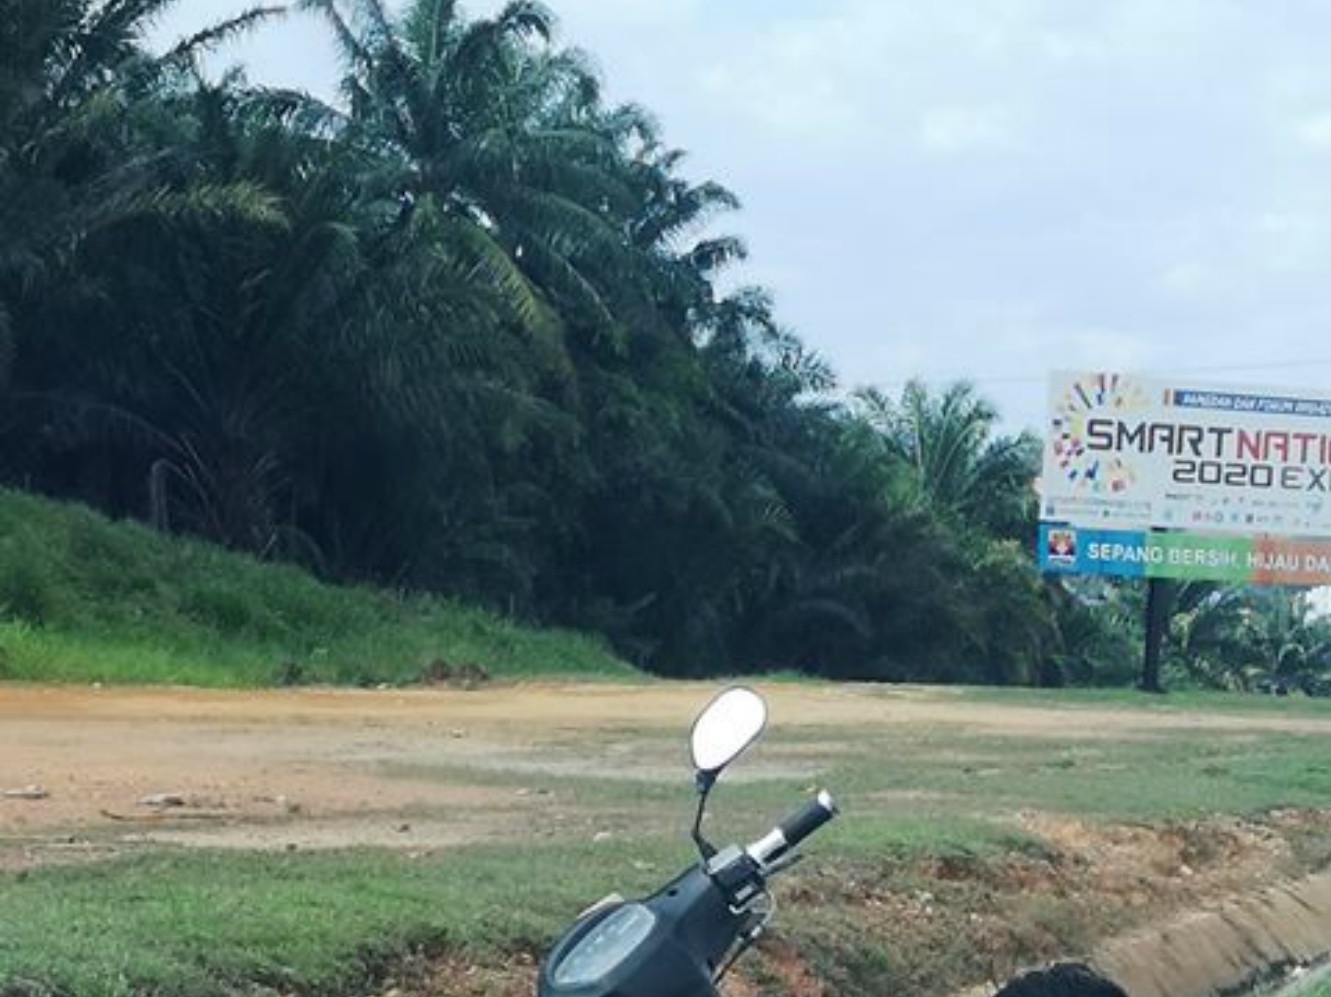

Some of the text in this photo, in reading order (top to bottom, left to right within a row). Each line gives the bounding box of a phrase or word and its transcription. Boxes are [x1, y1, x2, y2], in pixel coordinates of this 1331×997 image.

[1172, 460, 1274, 488] 2020
[1087, 543, 1163, 564] SEPANG
[1247, 551, 1300, 571] HIJAU
